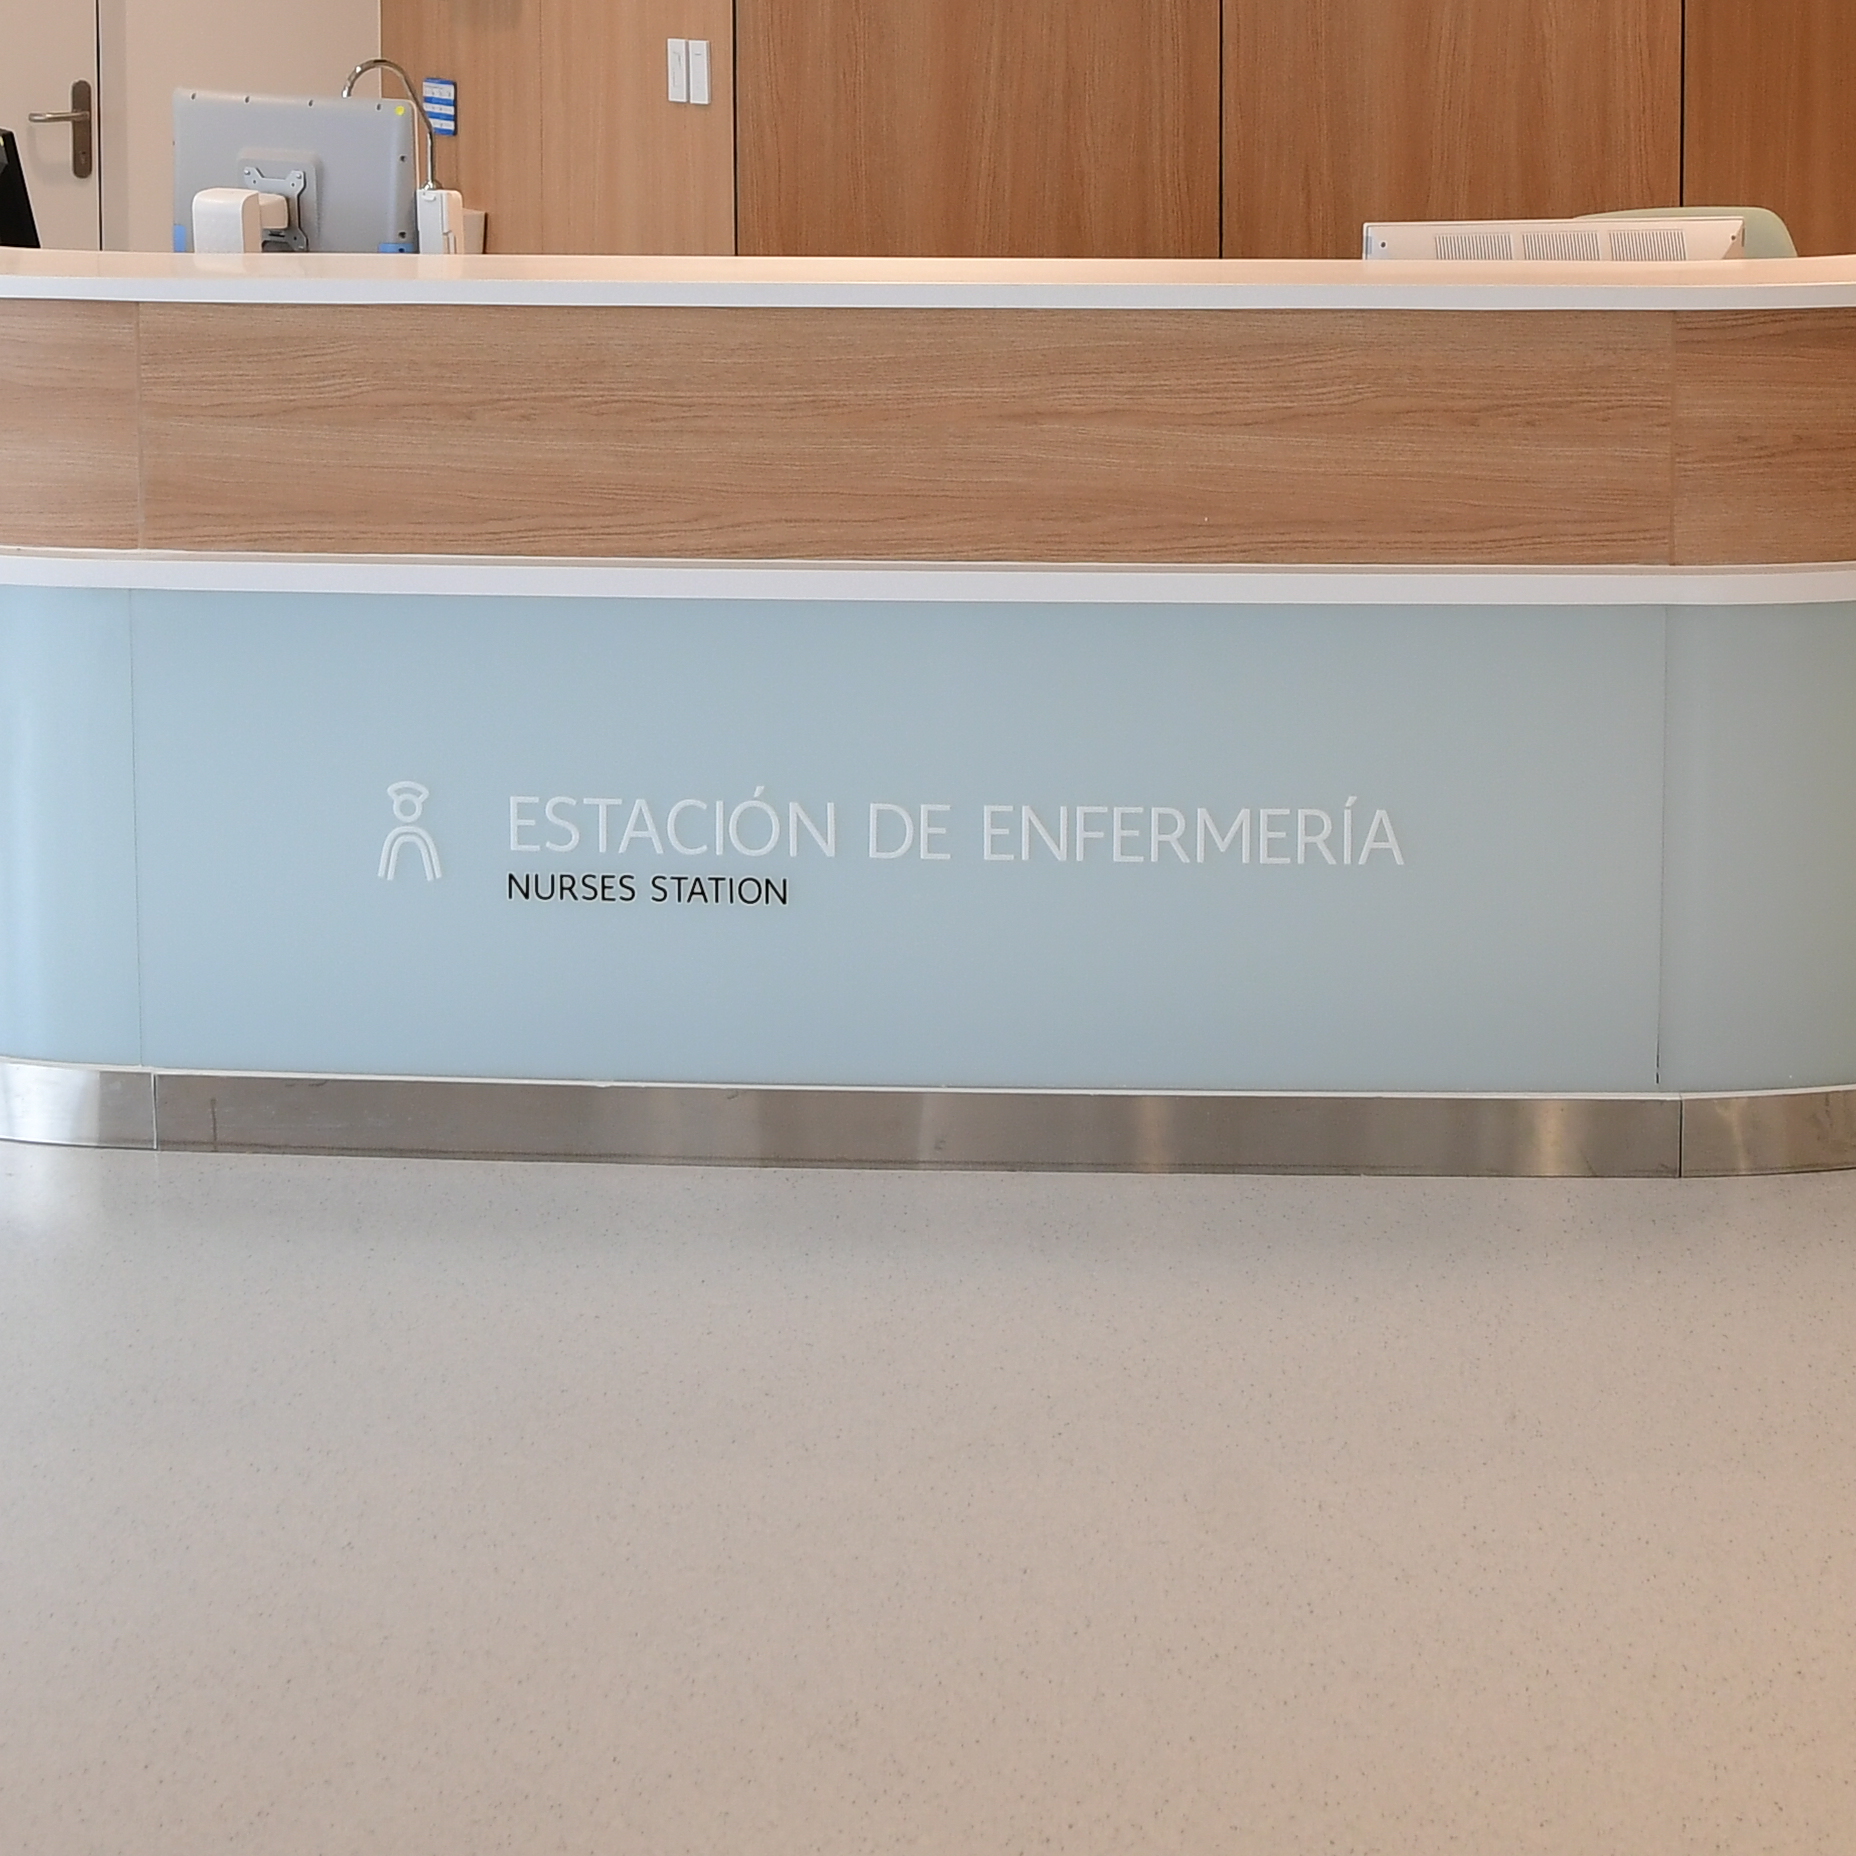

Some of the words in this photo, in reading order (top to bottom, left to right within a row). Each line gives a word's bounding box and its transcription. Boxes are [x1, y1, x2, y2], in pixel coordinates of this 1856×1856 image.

[509, 786, 836, 858] ESTACIÓN
[869, 802, 951, 860] DE
[983, 796, 1405, 866] ENFERMERÍA
[508, 872, 637, 902] NURSES
[651, 875, 787, 906] STATION
